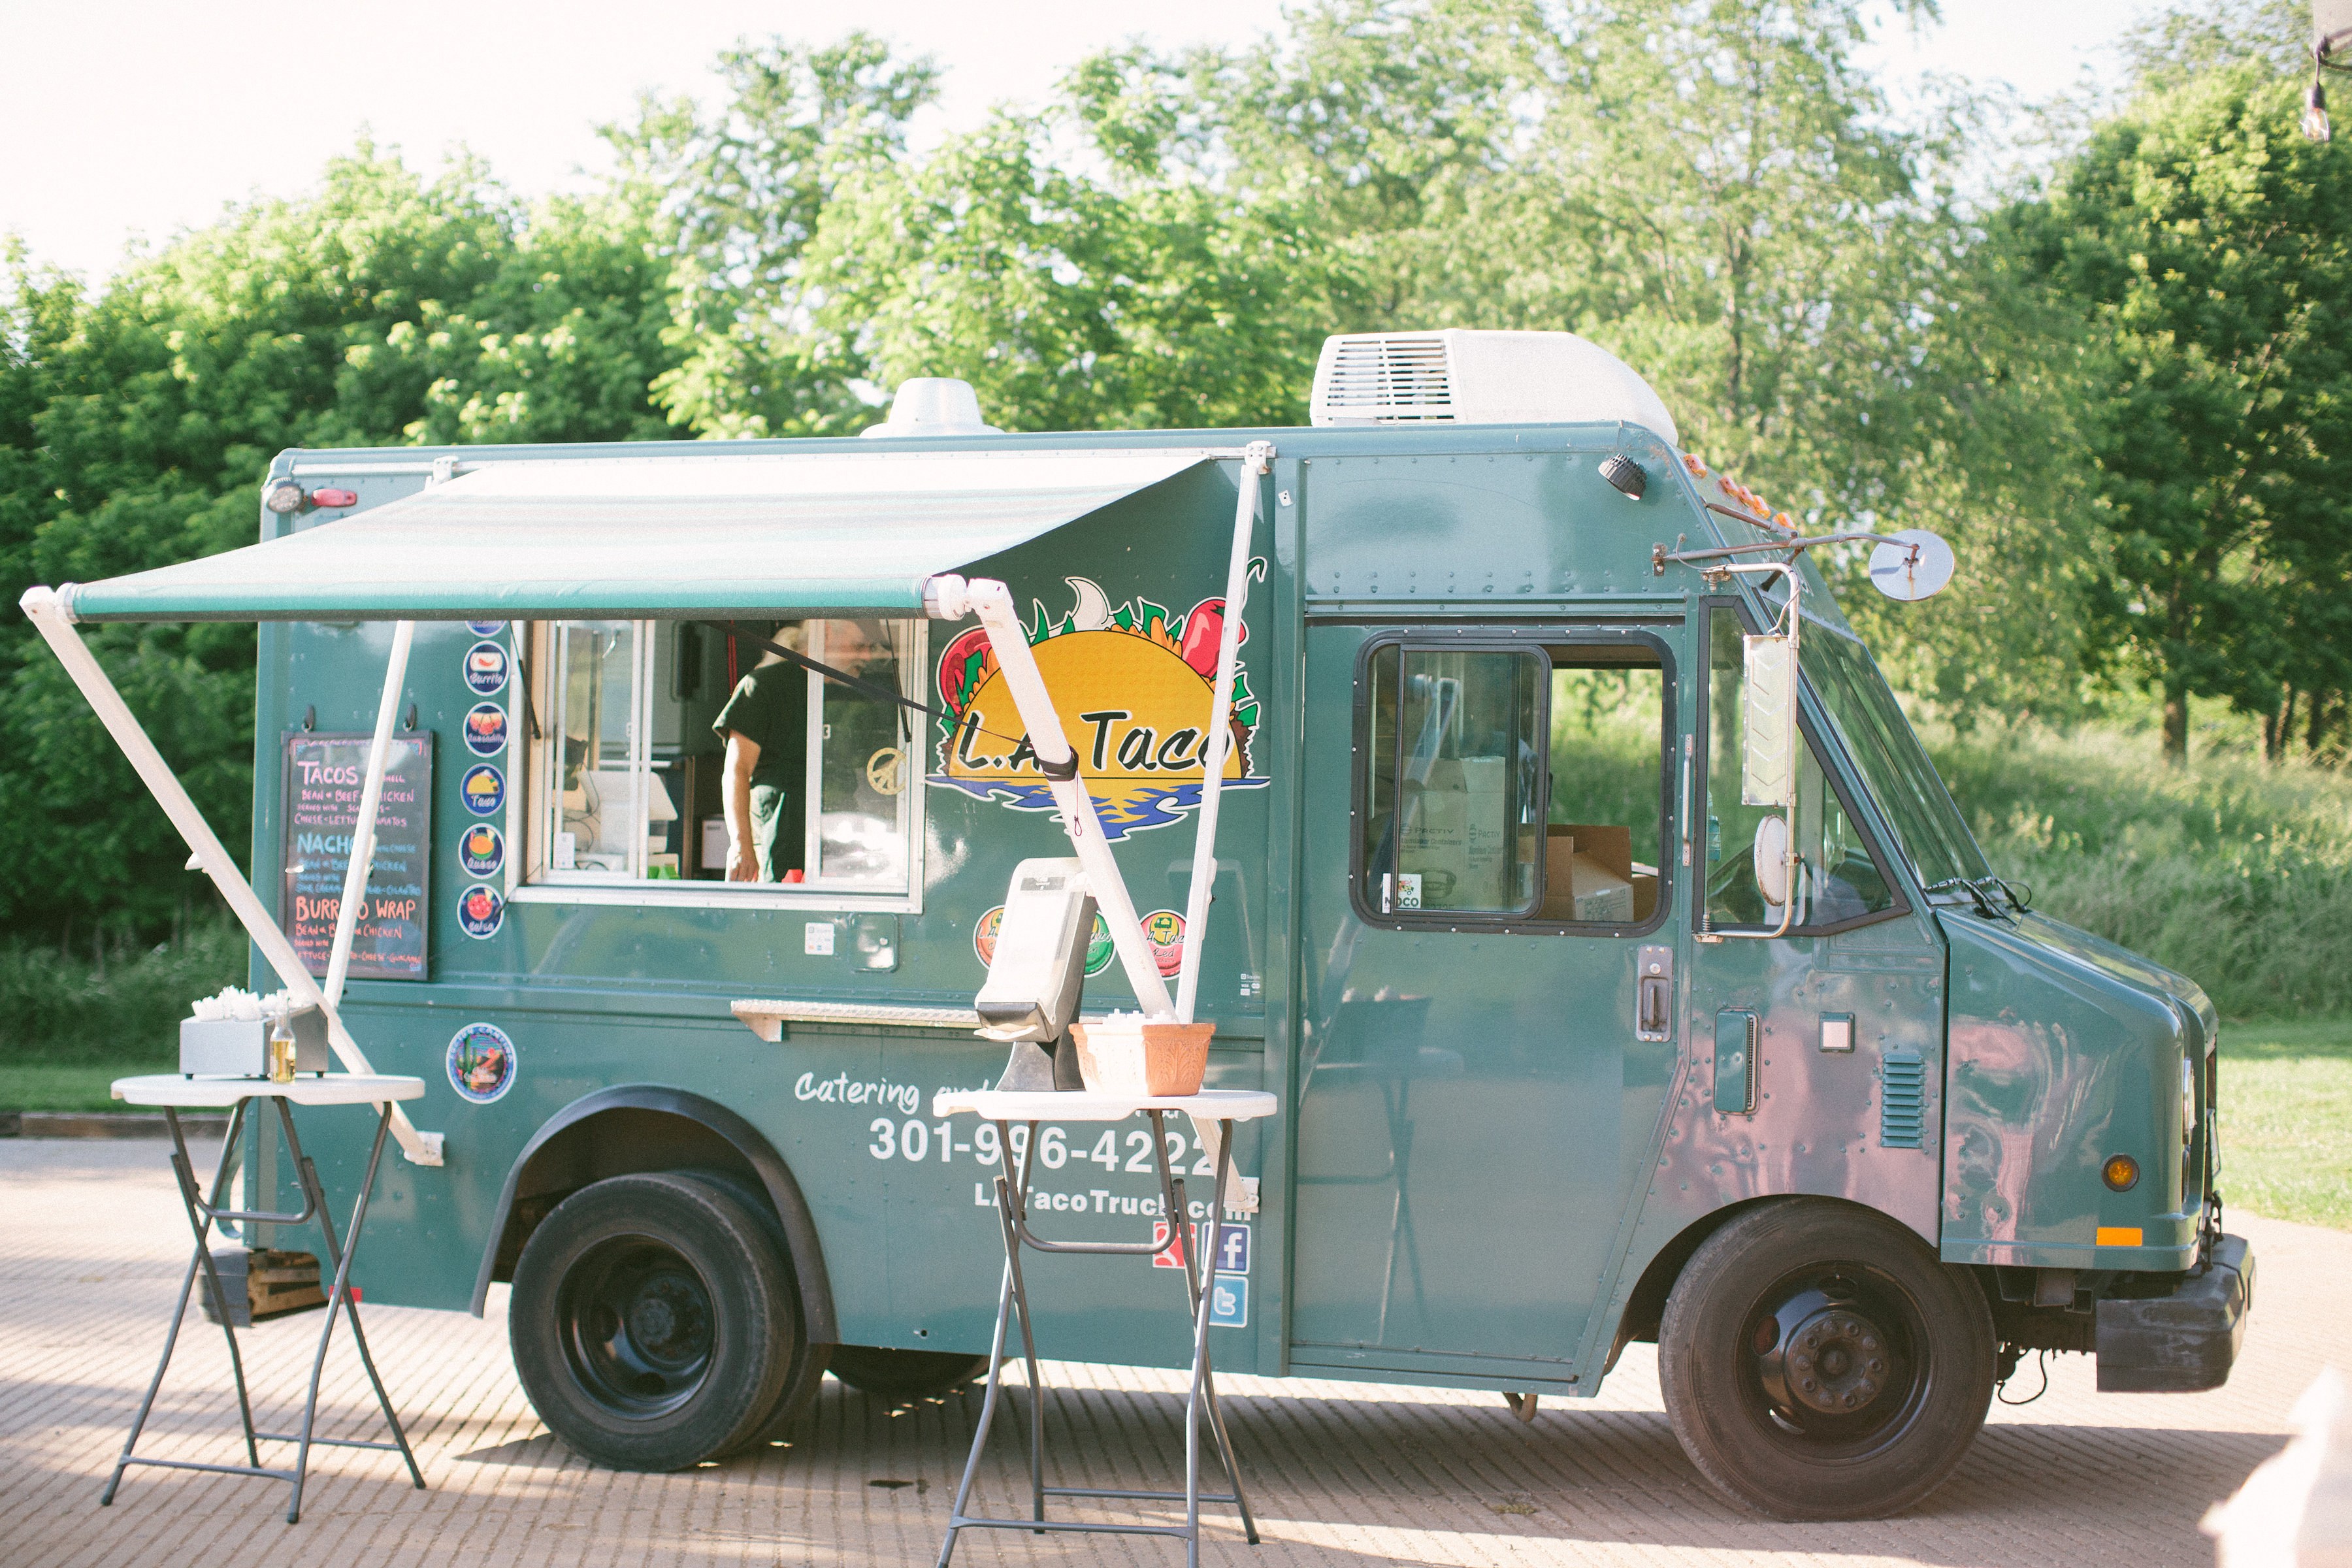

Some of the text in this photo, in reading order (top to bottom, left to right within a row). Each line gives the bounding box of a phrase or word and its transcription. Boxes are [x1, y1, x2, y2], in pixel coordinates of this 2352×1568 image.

[469, 672, 504, 685] Burrito
[297, 760, 359, 785] TACOS
[301, 789, 323, 801] BEAN
[380, 789, 414, 802] ICKEN
[470, 794, 497, 808] Taco
[376, 817, 407, 827] OMATOS
[296, 832, 355, 855] NACH
[466, 857, 498, 870] Queso
[295, 896, 416, 922] BURRO WRAP
[295, 923, 319, 936] BEAN
[363, 923, 402, 939] CHICKEN
[1162, 930, 1185, 944] Tac
[1152, 947, 1175, 958] Red
[794, 1071, 920, 1115] Catering
[868, 1116, 1217, 1177] 301-996-4222
[975, 1182, 1252, 1222] LacoTrucc
